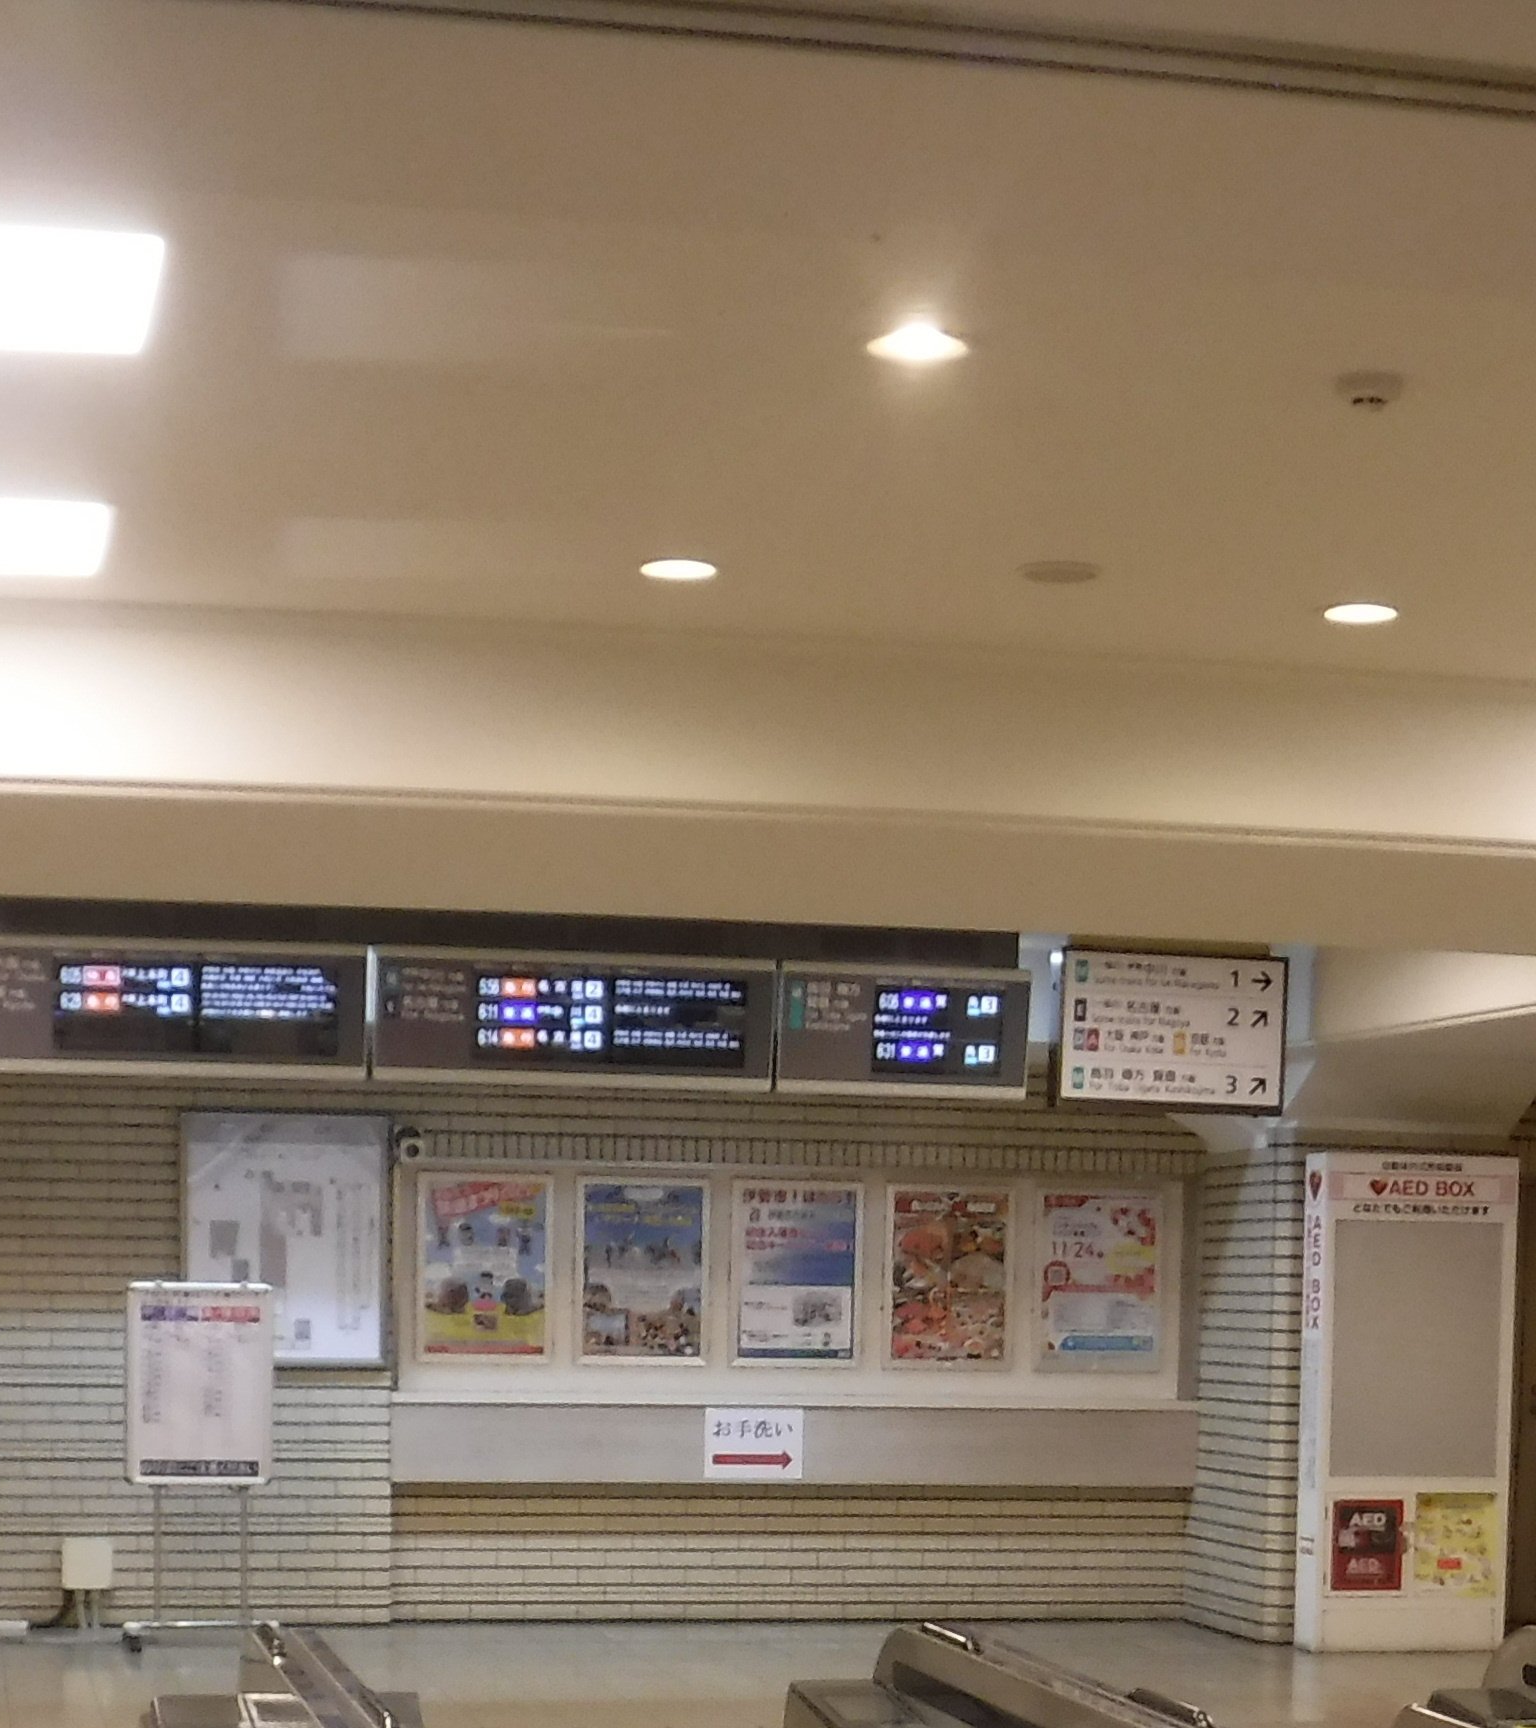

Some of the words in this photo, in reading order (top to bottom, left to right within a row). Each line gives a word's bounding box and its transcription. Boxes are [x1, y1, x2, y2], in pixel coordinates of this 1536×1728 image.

[1230, 969, 1240, 988] 1
[1227, 1007, 1240, 1026] 2
[1225, 1075, 1238, 1095] 3
[1389, 1180, 1428, 1197] AED
[1435, 1181, 1475, 1198] BOX
[1313, 1215, 1322, 1267] AED
[1312, 1279, 1321, 1330] BOX
[712, 1420, 793, 1439] お手洗い
[1349, 1512, 1387, 1526] AED
